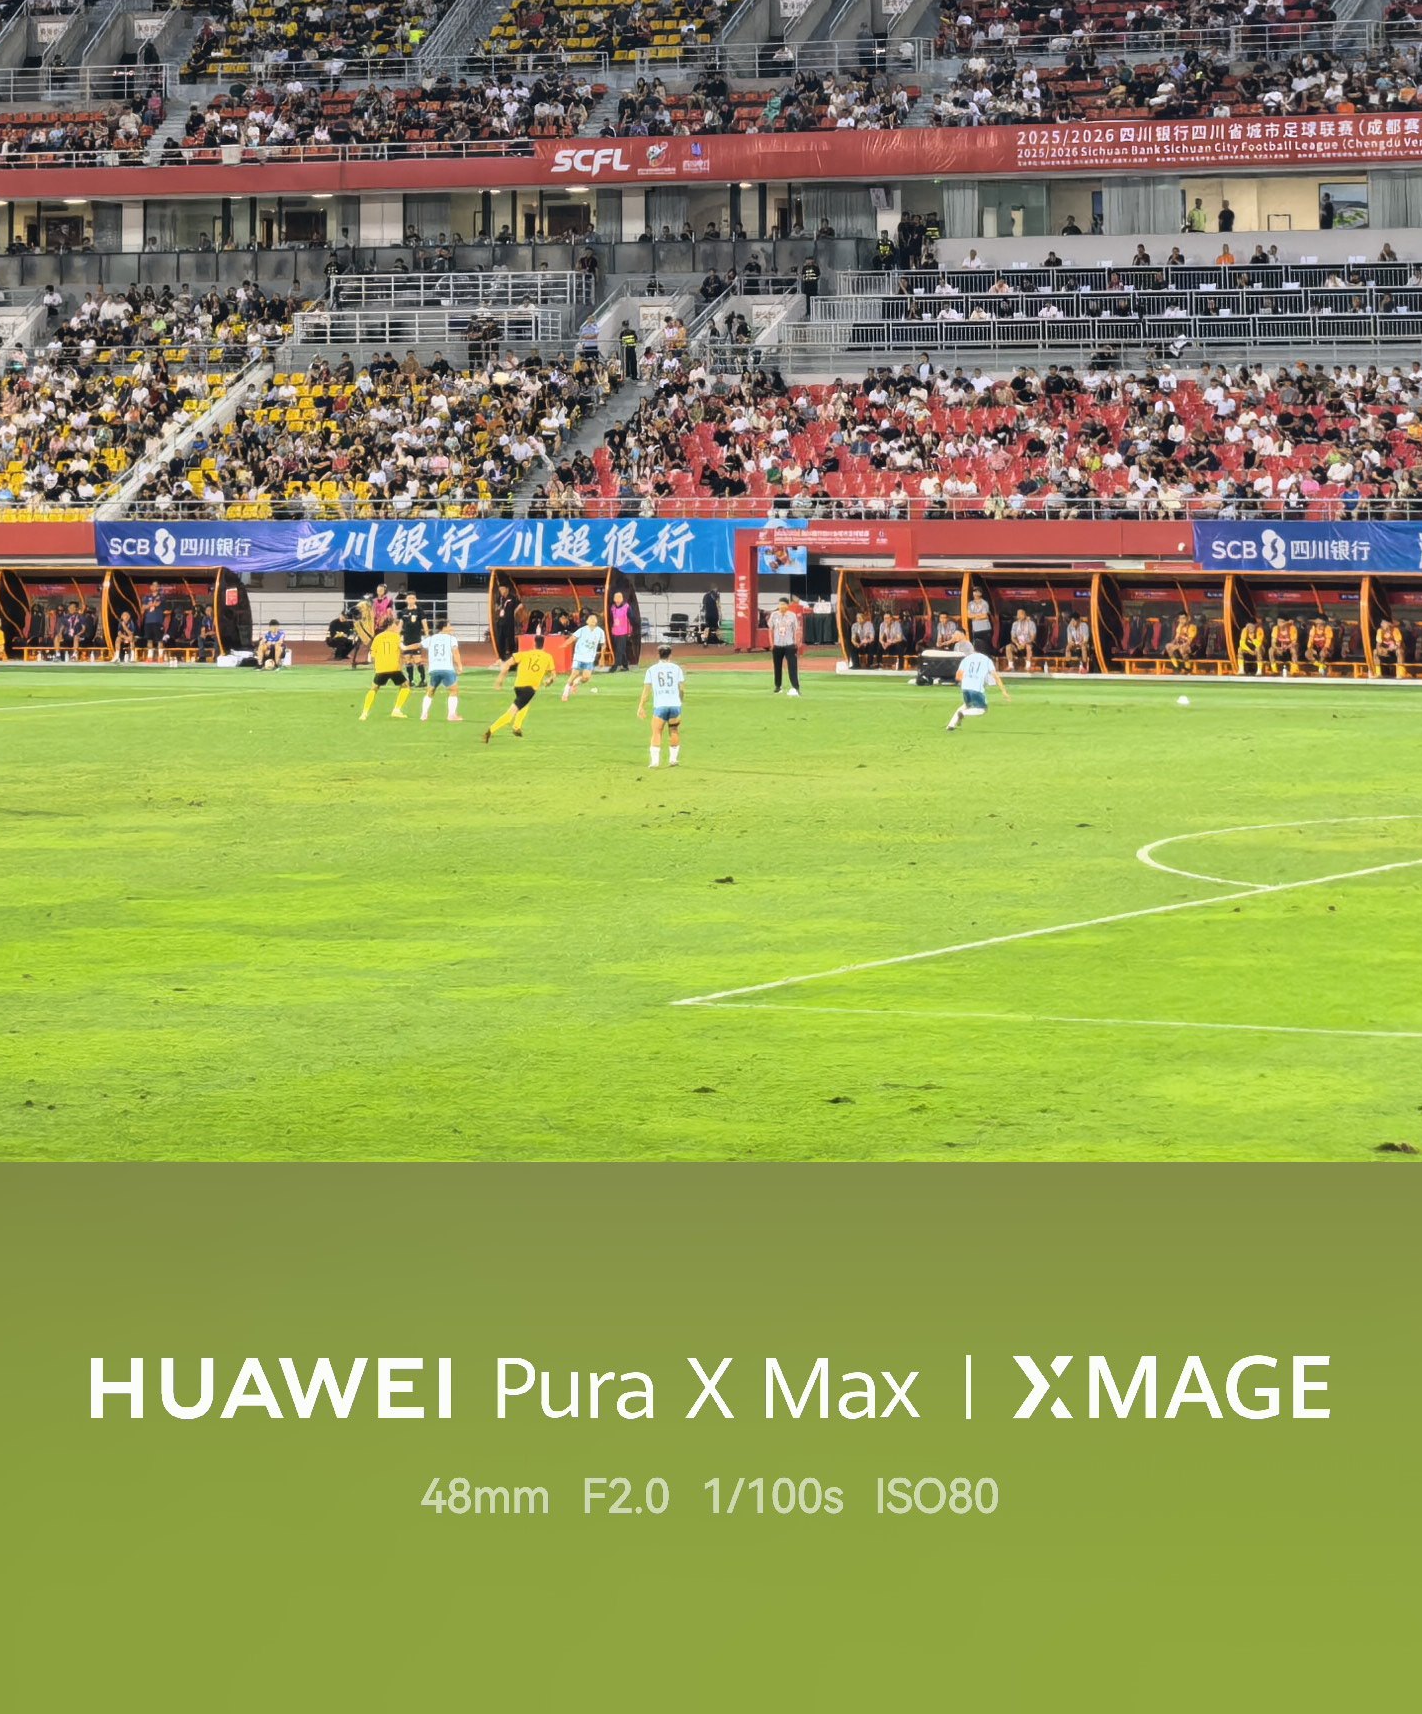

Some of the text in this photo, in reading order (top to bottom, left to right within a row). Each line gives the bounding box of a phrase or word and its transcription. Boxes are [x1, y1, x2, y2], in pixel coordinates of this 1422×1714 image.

[1016, 128, 1115, 147] 2025/2026
[1016, 145, 1079, 159] 2025/2026
[1081, 145, 1129, 157] Sichuan
[1131, 144, 1161, 155] Bank
[1163, 143, 1212, 154] Sichuan
[1214, 141, 1239, 154] City
[1241, 140, 1292, 152] Football
[1294, 139, 1339, 152] League
[550, 148, 631, 177] SCFL
[109, 537, 252, 558] SCB 四川银行
[295, 521, 696, 571] 四川银行 川超很行
[1211, 538, 1371, 561] SCB 四川银行
[657, 671, 674, 688] 65
